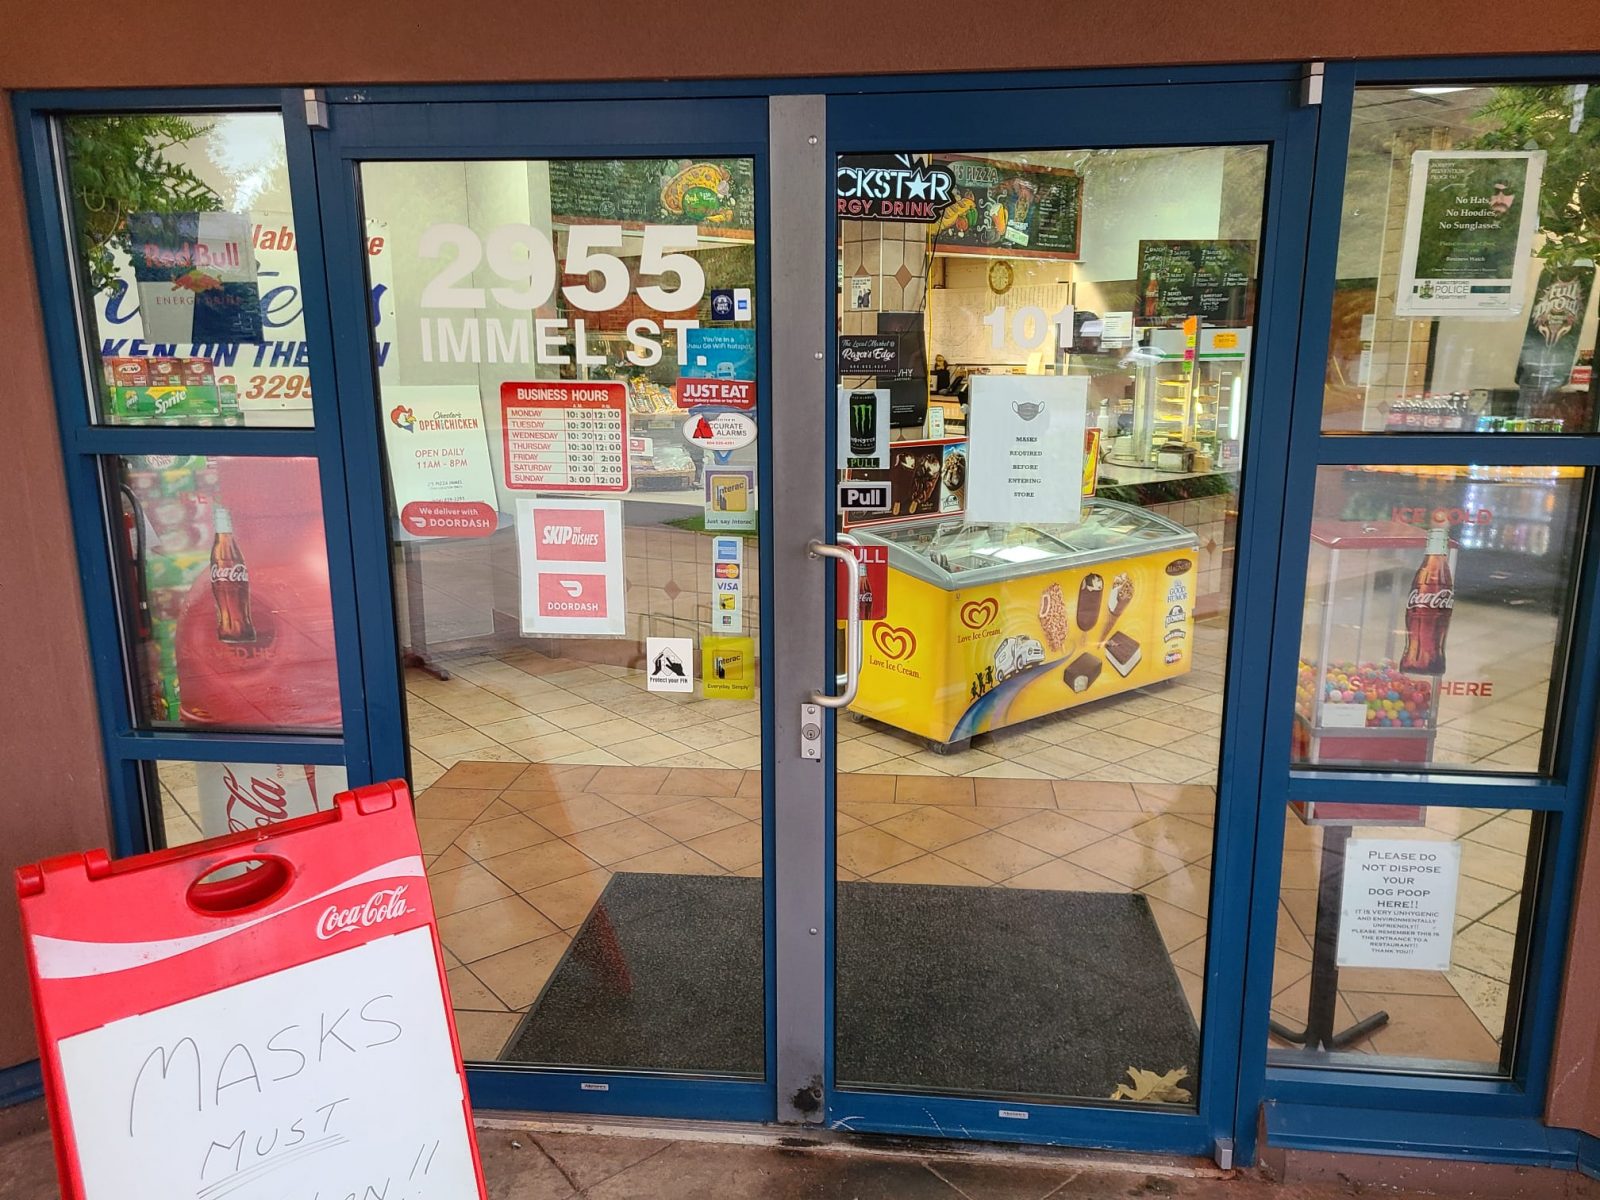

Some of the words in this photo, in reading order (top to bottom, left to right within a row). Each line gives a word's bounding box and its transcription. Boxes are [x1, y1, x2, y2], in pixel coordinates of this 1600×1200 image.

[965, 166, 998, 182] PIZZA
[1455, 196, 1468, 204] No
[1470, 196, 1491, 205] Hats,
[881, 200, 935, 217] DRINK
[1446, 209, 1459, 217] No
[1460, 208, 1498, 218] Hoodies,
[1453, 221, 1502, 231] Sunglasses.
[144, 242, 192, 268] Red
[193, 242, 240, 266] Bull
[419, 223, 706, 313] 2955
[1435, 286, 1470, 294] POLICE
[984, 304, 1074, 348] 101
[420, 318, 607, 365] IMMEL
[626, 318, 707, 367] ST.
[872, 348, 896, 362] Edge
[517, 388, 568, 400] BUSINESS
[572, 389, 608, 401] HOURS
[683, 384, 719, 398] JUST
[721, 384, 749, 398] EAT
[155, 391, 187, 414] Sprite
[419, 419, 440, 431] OPEN
[444, 418, 478, 430] CHICKEN
[415, 449, 438, 458] OPEN
[442, 448, 465, 456] DAILY
[417, 460, 440, 469] 11AM
[449, 459, 468, 468] 8PM
[850, 458, 877, 468] PULL
[716, 482, 744, 495] Interac
[848, 490, 880, 505] Pull
[419, 507, 432, 515] We
[434, 507, 460, 515] deliver
[461, 508, 478, 516] with
[1392, 507, 1426, 523] ICE
[1432, 508, 1492, 526] COLD
[430, 518, 490, 528] DOORDASH
[542, 525, 573, 545] SKIP
[573, 526, 582, 534] THE
[572, 534, 598, 546] DISHES
[840, 548, 886, 564] ULL
[718, 582, 739, 591] VISA
[1407, 588, 1454, 610] Coca-Cola
[548, 602, 598, 612] DOORDASH
[958, 635, 972, 644] Love
[972, 632, 982, 640] Ice
[982, 629, 1001, 638] Cream
[716, 655, 741, 666] Interac
[869, 655, 885, 668] Love
[886, 660, 896, 670] Ice
[896, 664, 920, 679] Cream
[1438, 681, 1494, 697] HERE
[1368, 850, 1416, 860] PLEASE
[1419, 853, 1436, 862] DO
[1389, 864, 1441, 874] DISPOSE
[1383, 876, 1415, 884] YOUR
[1368, 888, 1394, 896] DOG
[1396, 889, 1430, 897] POOP
[1377, 900, 1418, 909] HERE!!
[316, 884, 408, 940] Coca-Cola
[130, 995, 402, 1137] MASKS
[200, 1098, 349, 1180] MUST
